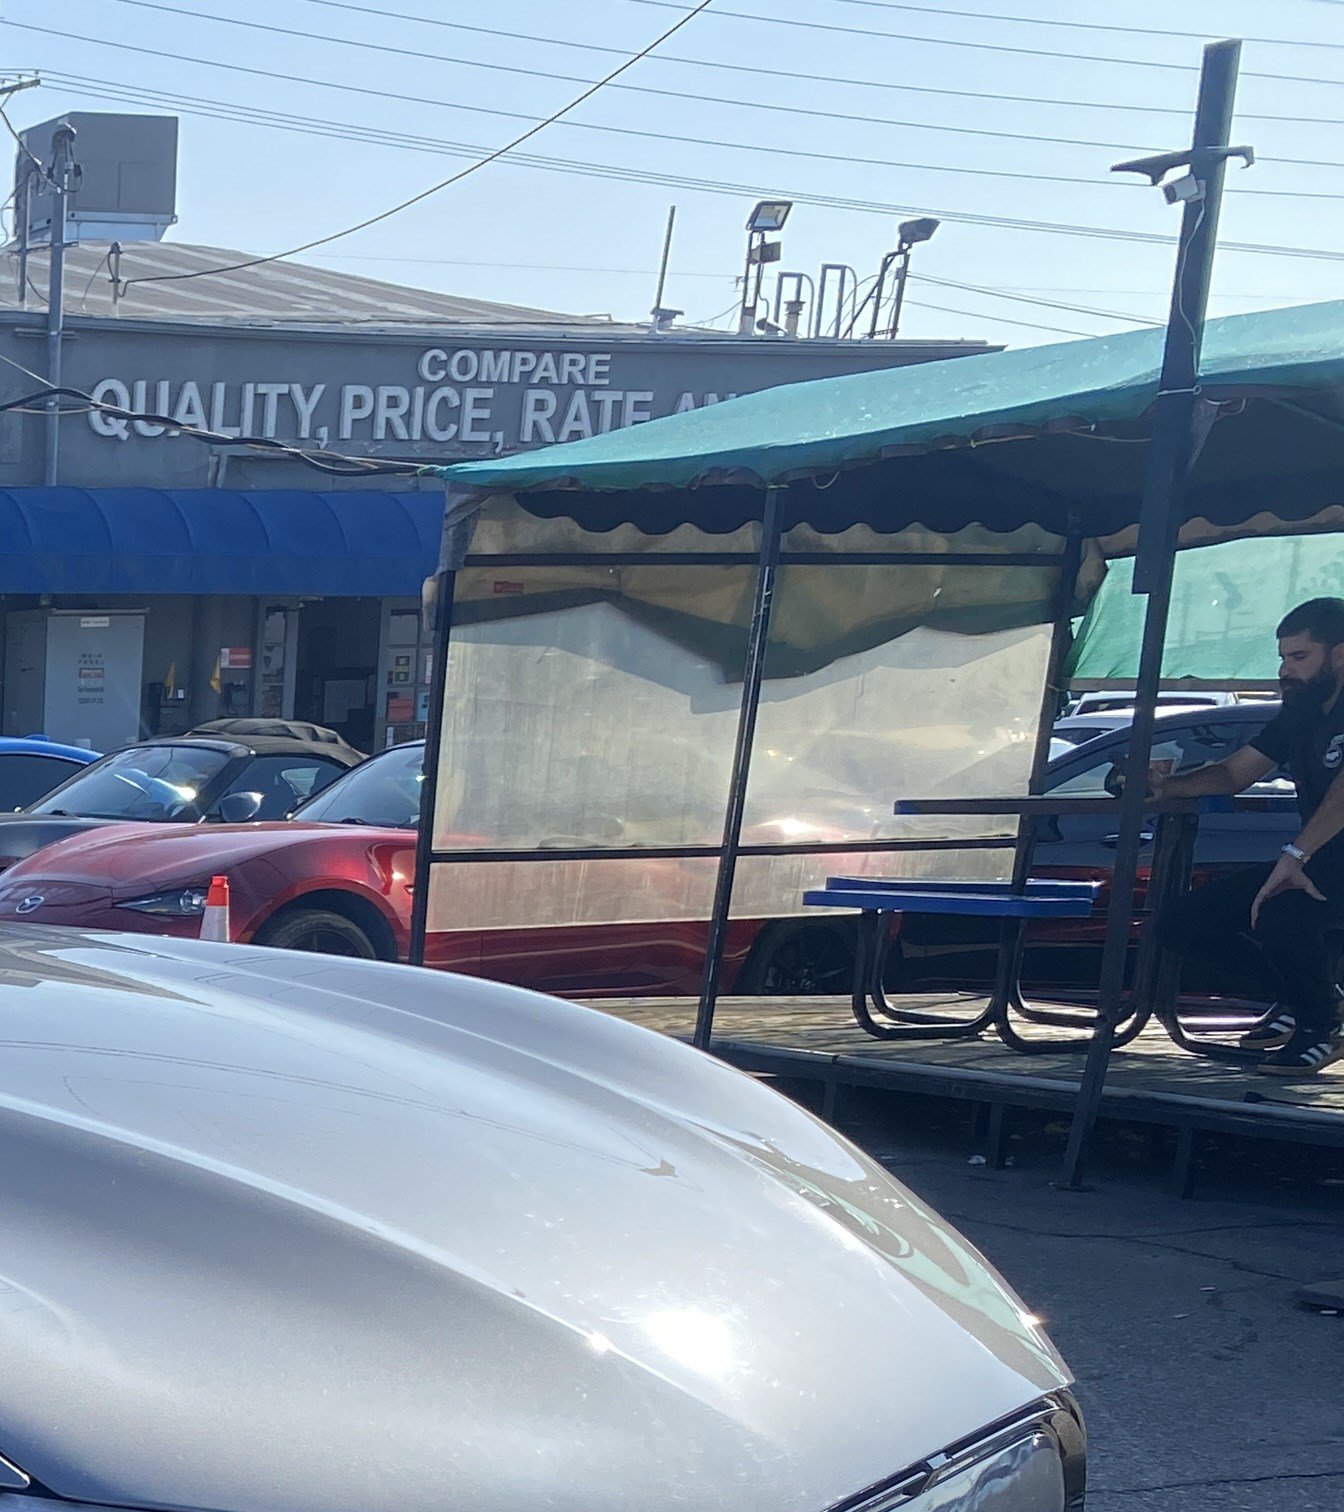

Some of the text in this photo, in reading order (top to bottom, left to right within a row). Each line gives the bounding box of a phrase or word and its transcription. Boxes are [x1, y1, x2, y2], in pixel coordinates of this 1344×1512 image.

[418, 348, 612, 386] COMPARE
[88, 378, 655, 454] QUALITY, PRICE, RATE
